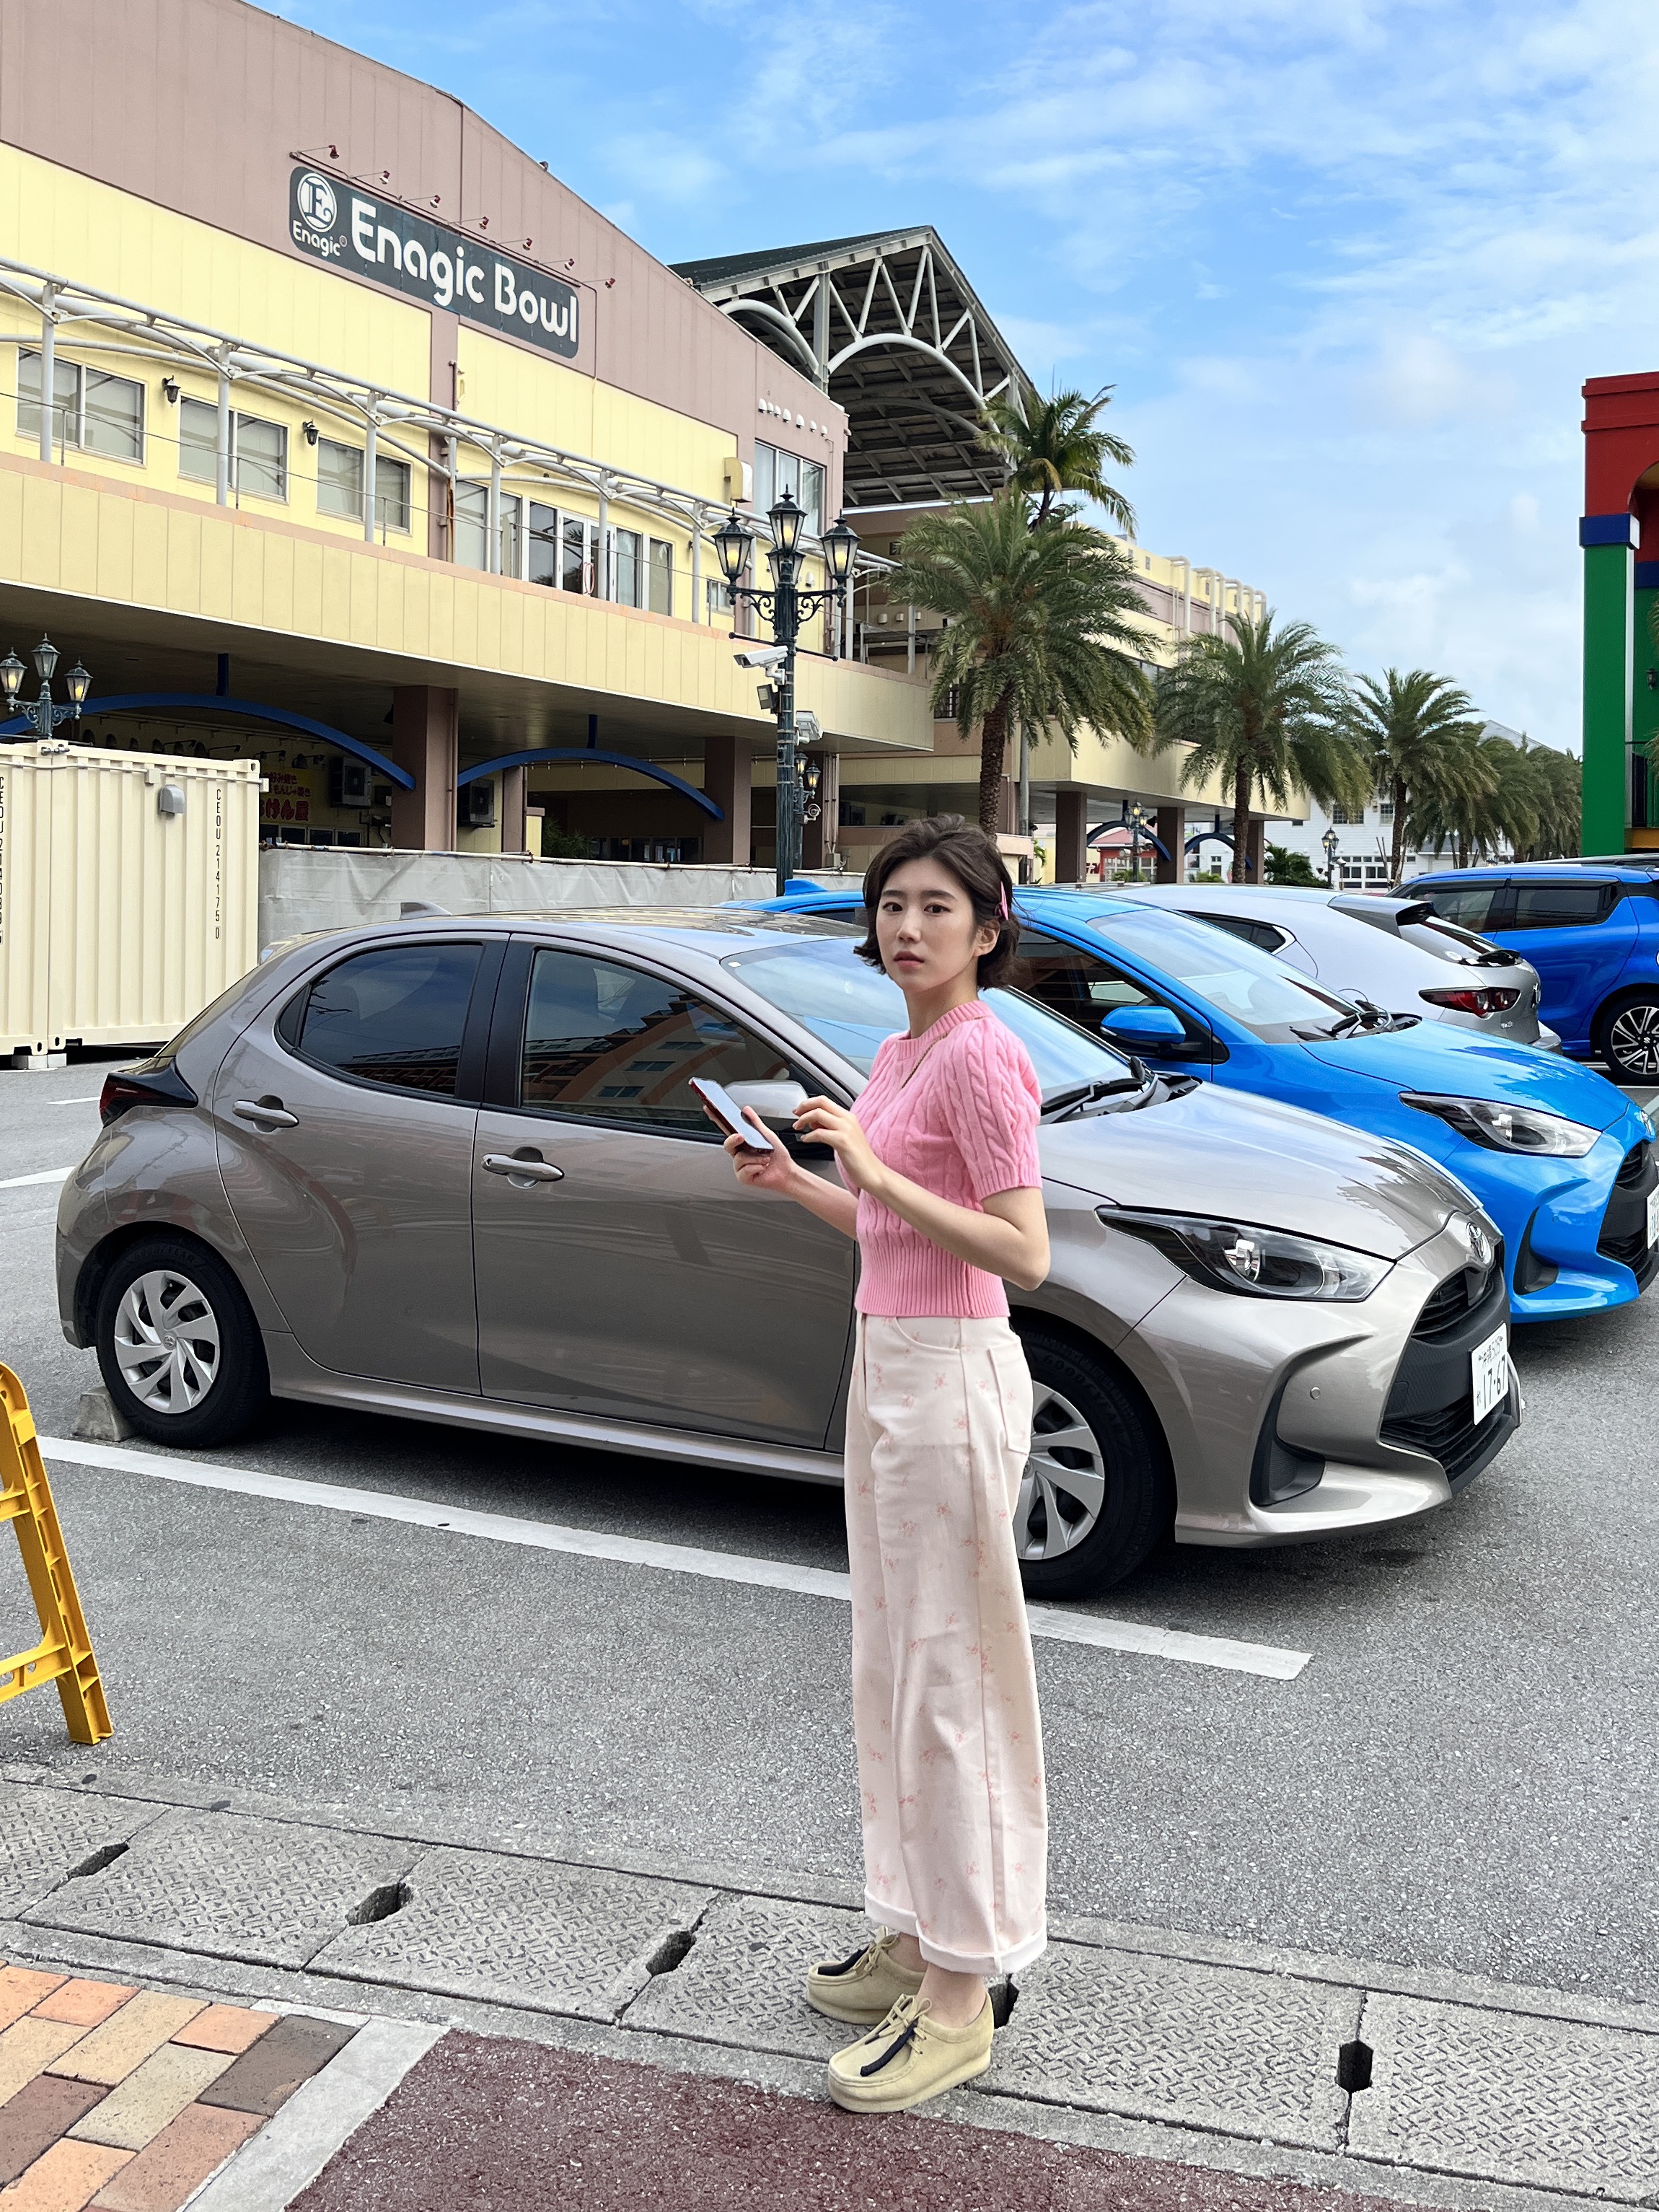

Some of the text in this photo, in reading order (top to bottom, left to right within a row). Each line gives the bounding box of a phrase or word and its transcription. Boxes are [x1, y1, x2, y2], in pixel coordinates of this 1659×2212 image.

[292, 219, 341, 258] Enagic
[351, 197, 577, 343] Enagic Bowl
